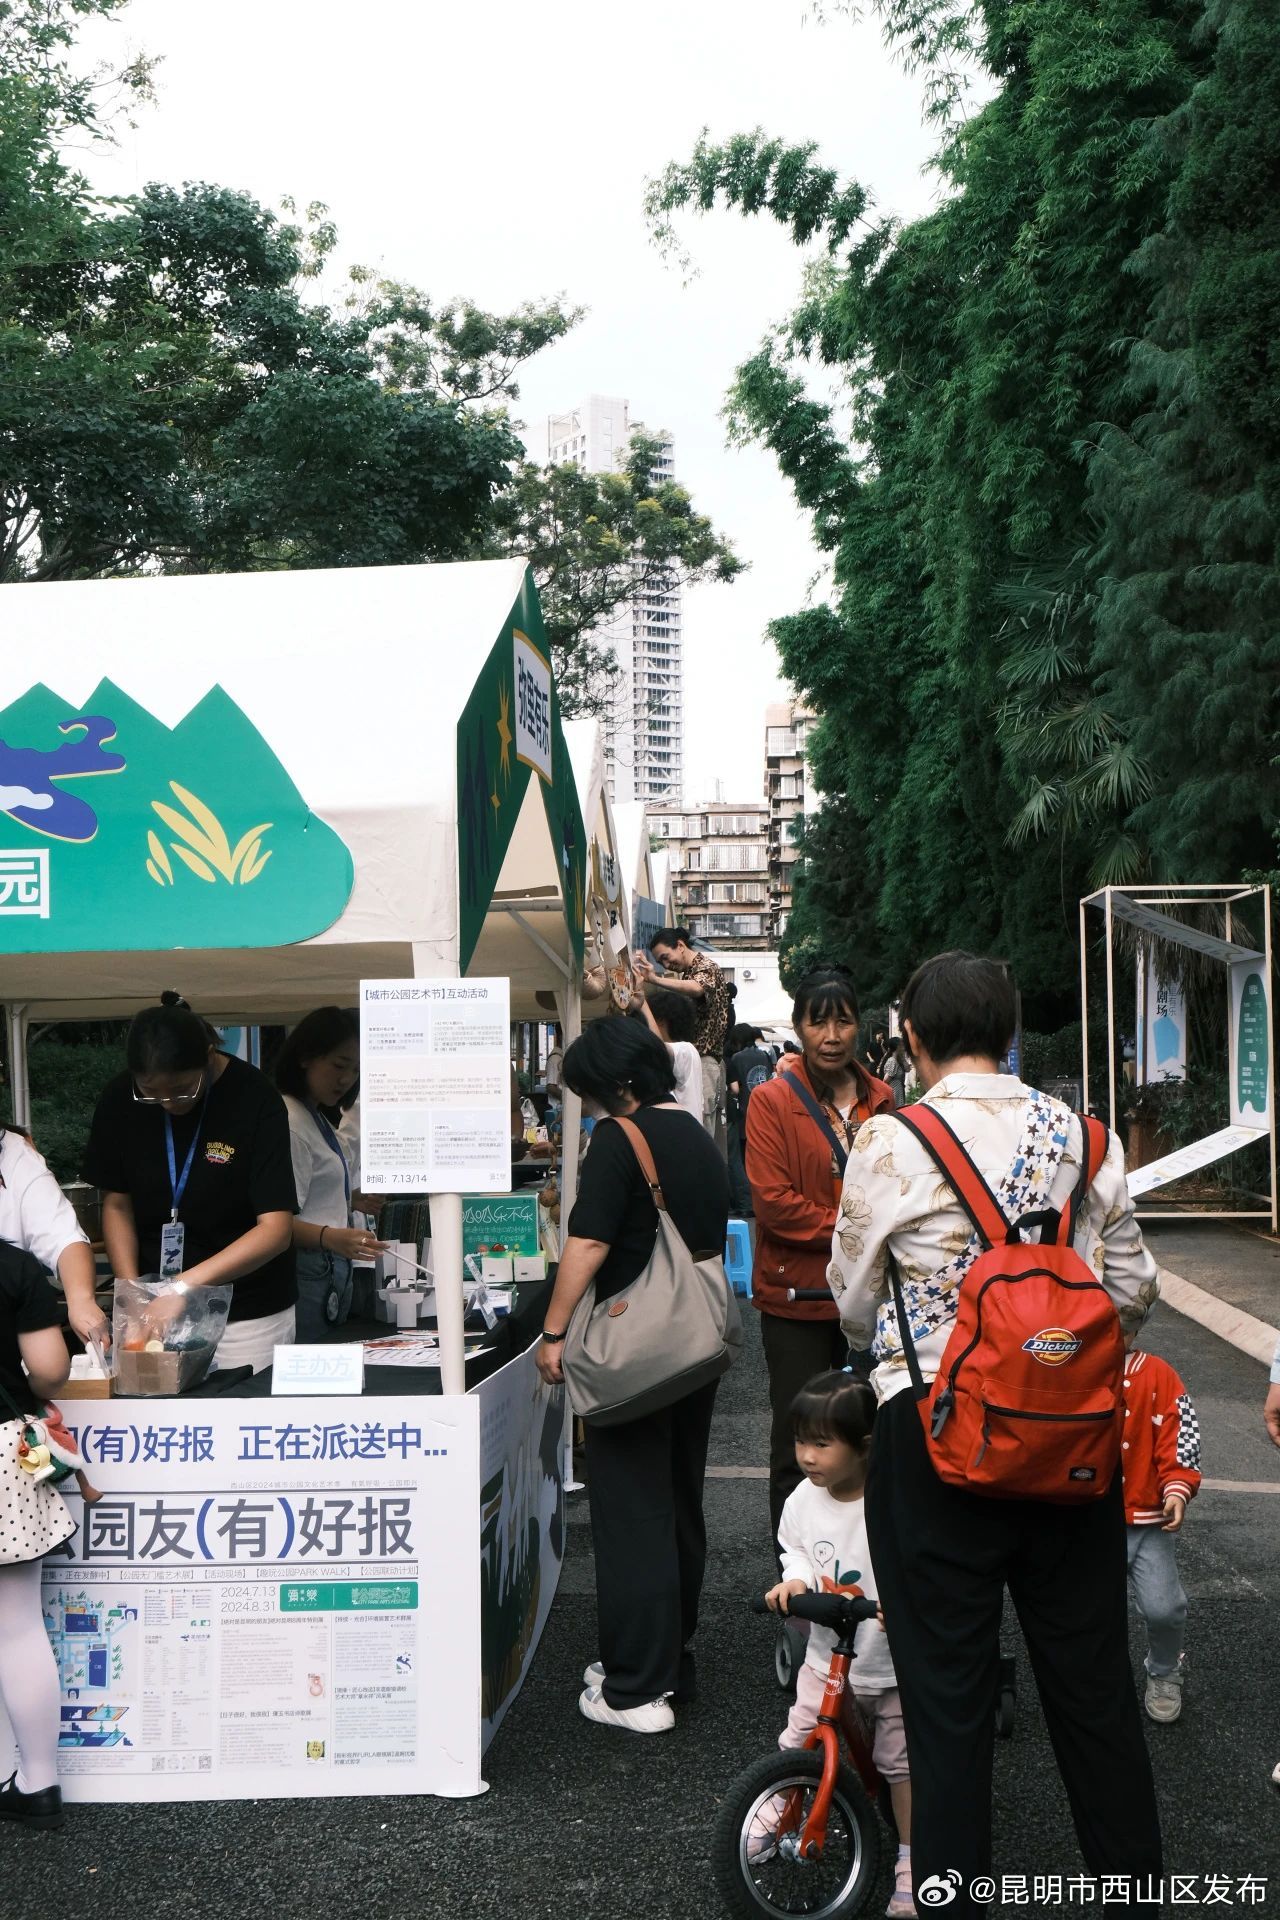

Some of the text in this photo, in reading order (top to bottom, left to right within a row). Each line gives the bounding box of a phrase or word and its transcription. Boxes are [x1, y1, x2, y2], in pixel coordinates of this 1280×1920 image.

[518, 655, 549, 756] 弥里有乐
[0, 848, 50, 919] 园
[1030, 1341, 1078, 1351] Dickies
[68, 1425, 215, 1464] (有)好报
[237, 1421, 448, 1461] 正在派送中...
[220, 1586, 276, 1597] 2024.7.13
[220, 1601, 276, 1613] 2024.8.31
